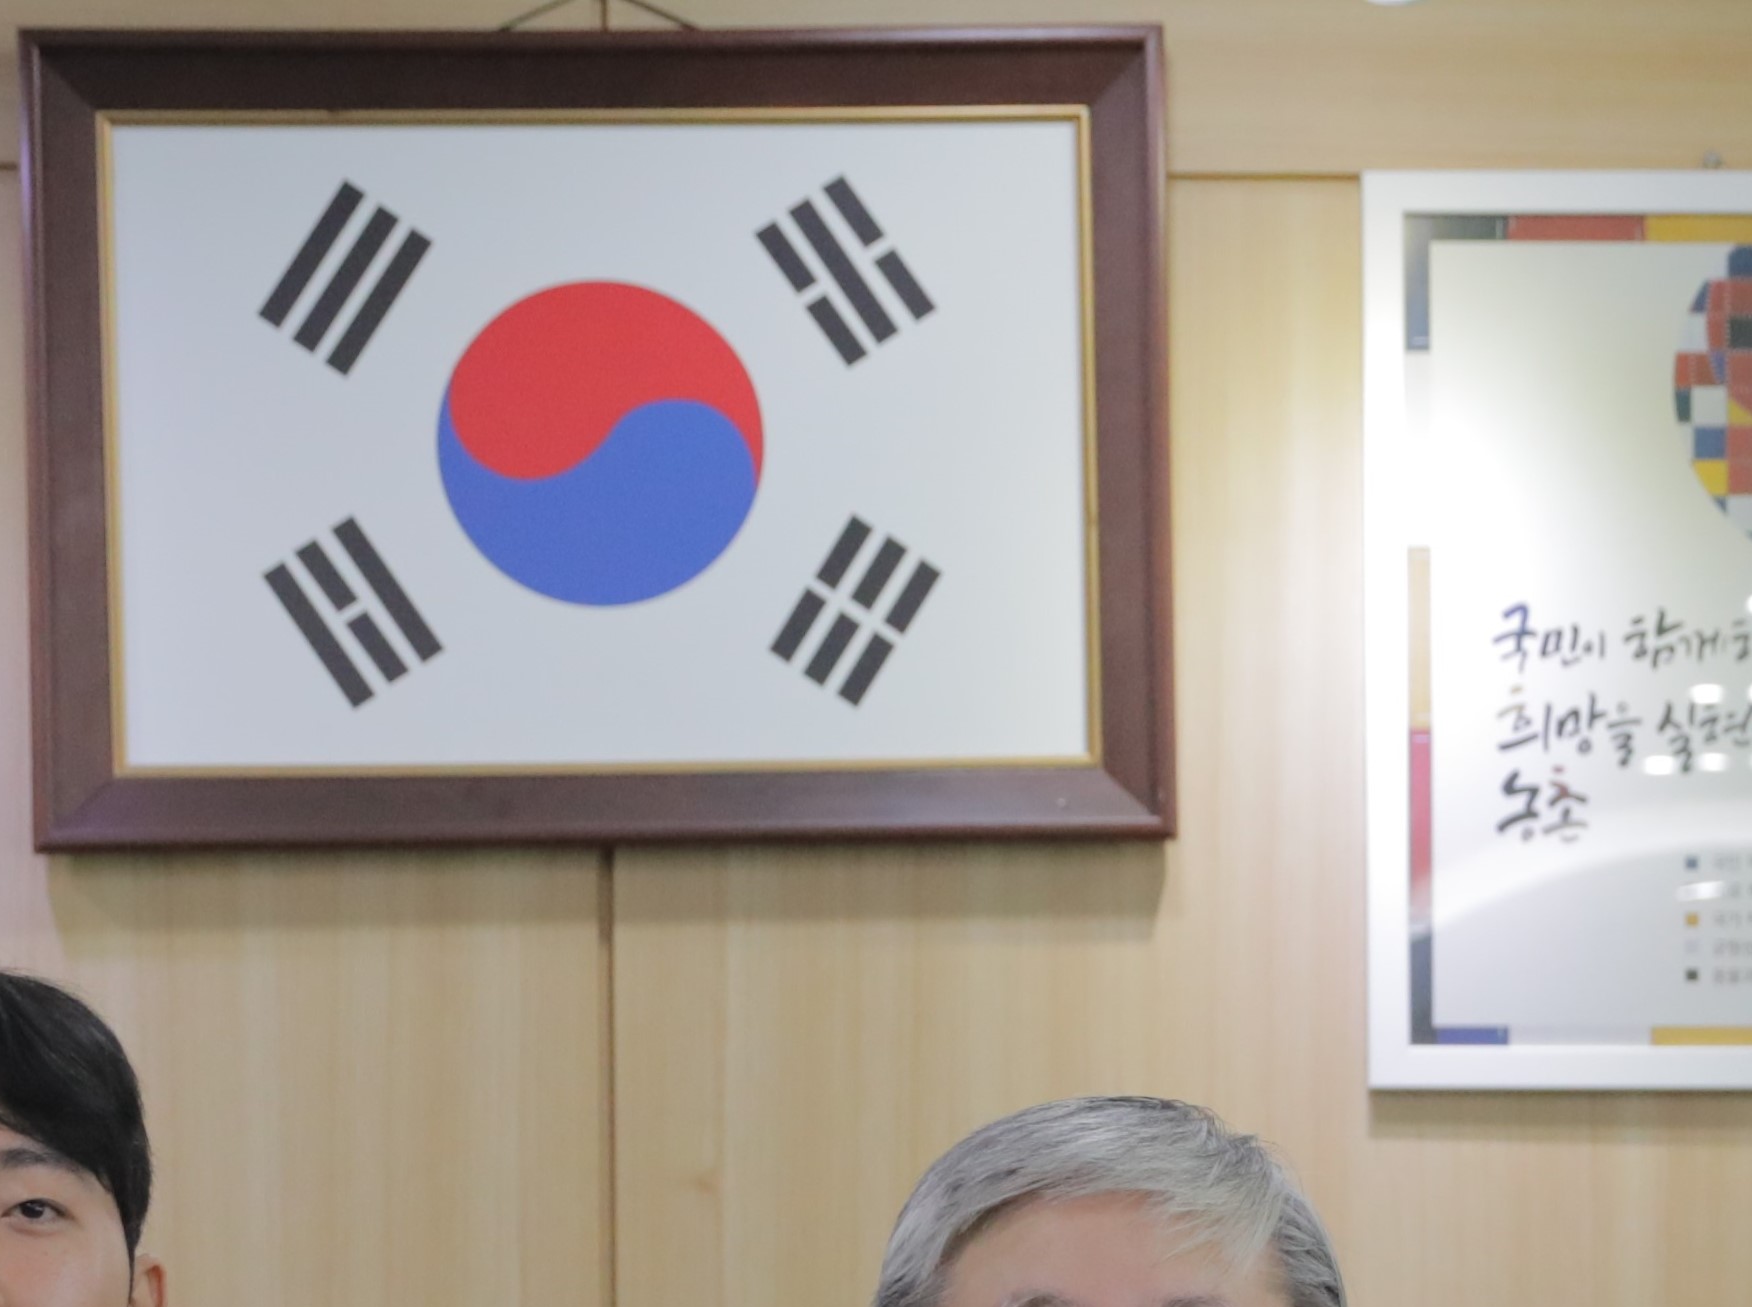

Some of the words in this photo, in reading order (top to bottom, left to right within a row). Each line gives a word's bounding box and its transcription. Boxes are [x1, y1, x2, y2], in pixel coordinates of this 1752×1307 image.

[1493, 602, 1606, 672] 국민이
[1497, 685, 1642, 769] 희망을
[1497, 765, 1588, 844] 농촌
